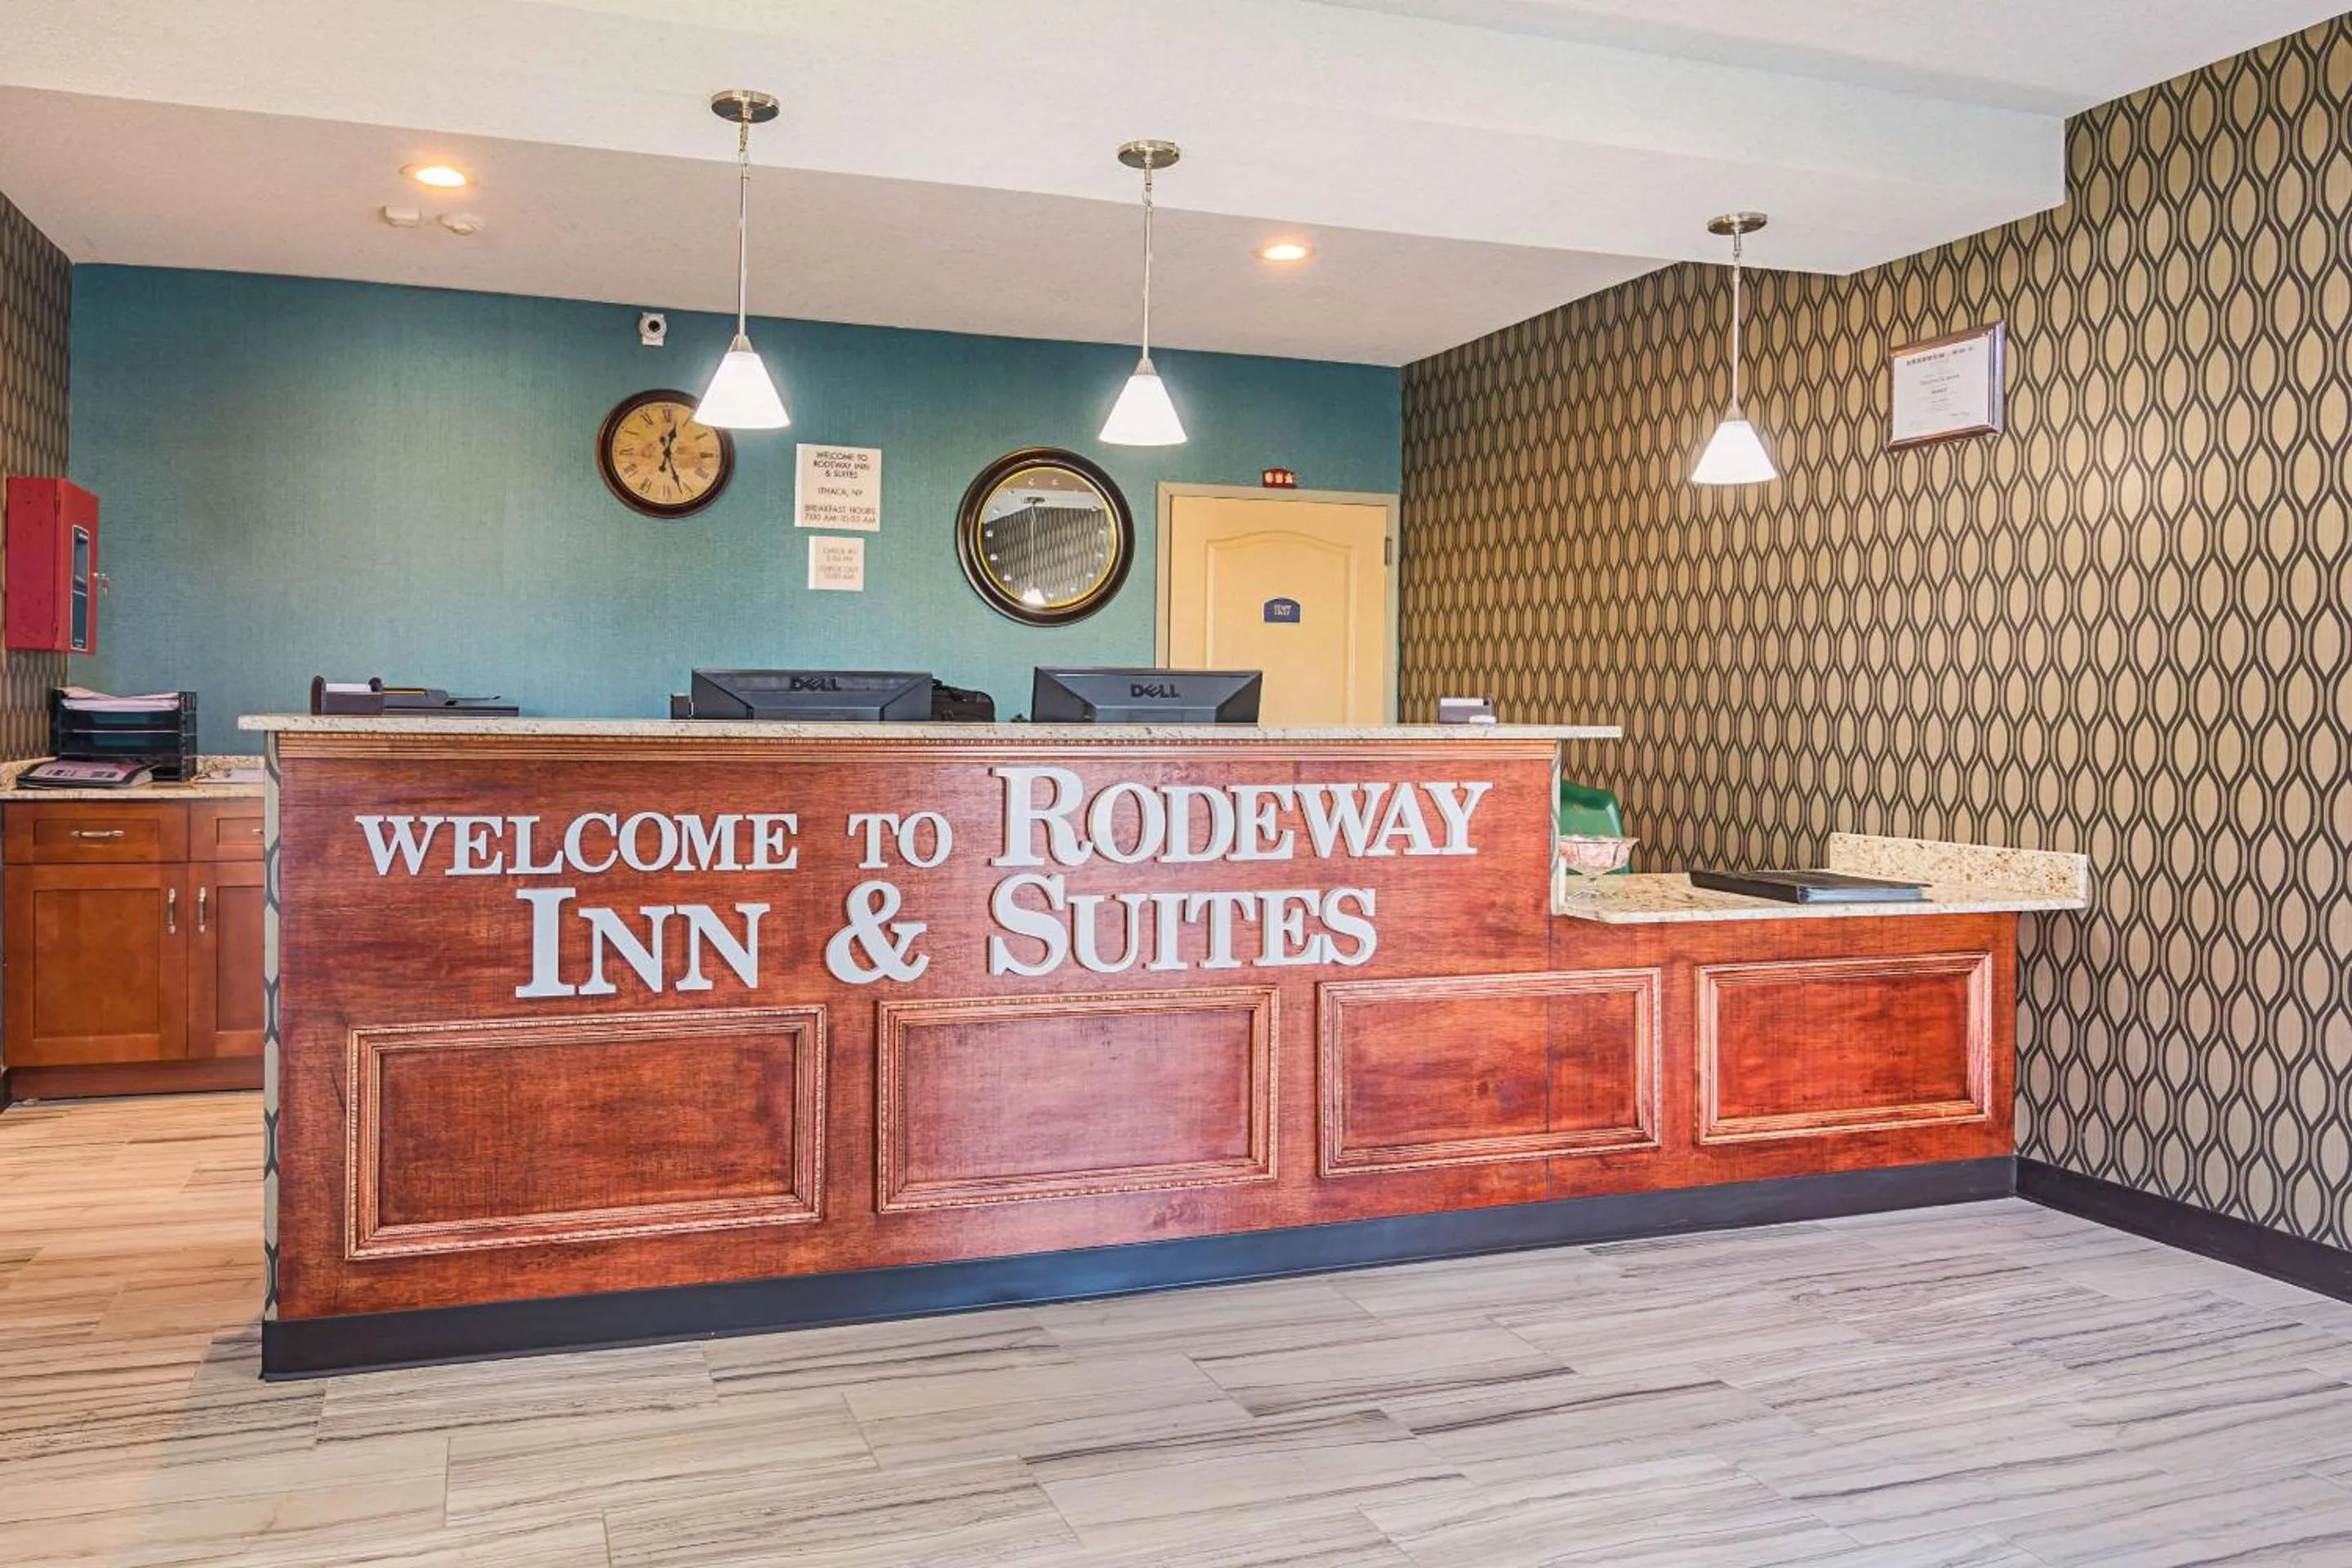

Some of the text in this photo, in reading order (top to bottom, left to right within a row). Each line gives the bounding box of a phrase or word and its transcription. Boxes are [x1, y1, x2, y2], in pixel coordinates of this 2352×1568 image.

[791, 676, 842, 692] DELL
[1130, 683, 1181, 698] DELL
[354, 765, 1494, 876] WELCOME TO RODEWAY
[514, 872, 1379, 999] INN & SUITES
